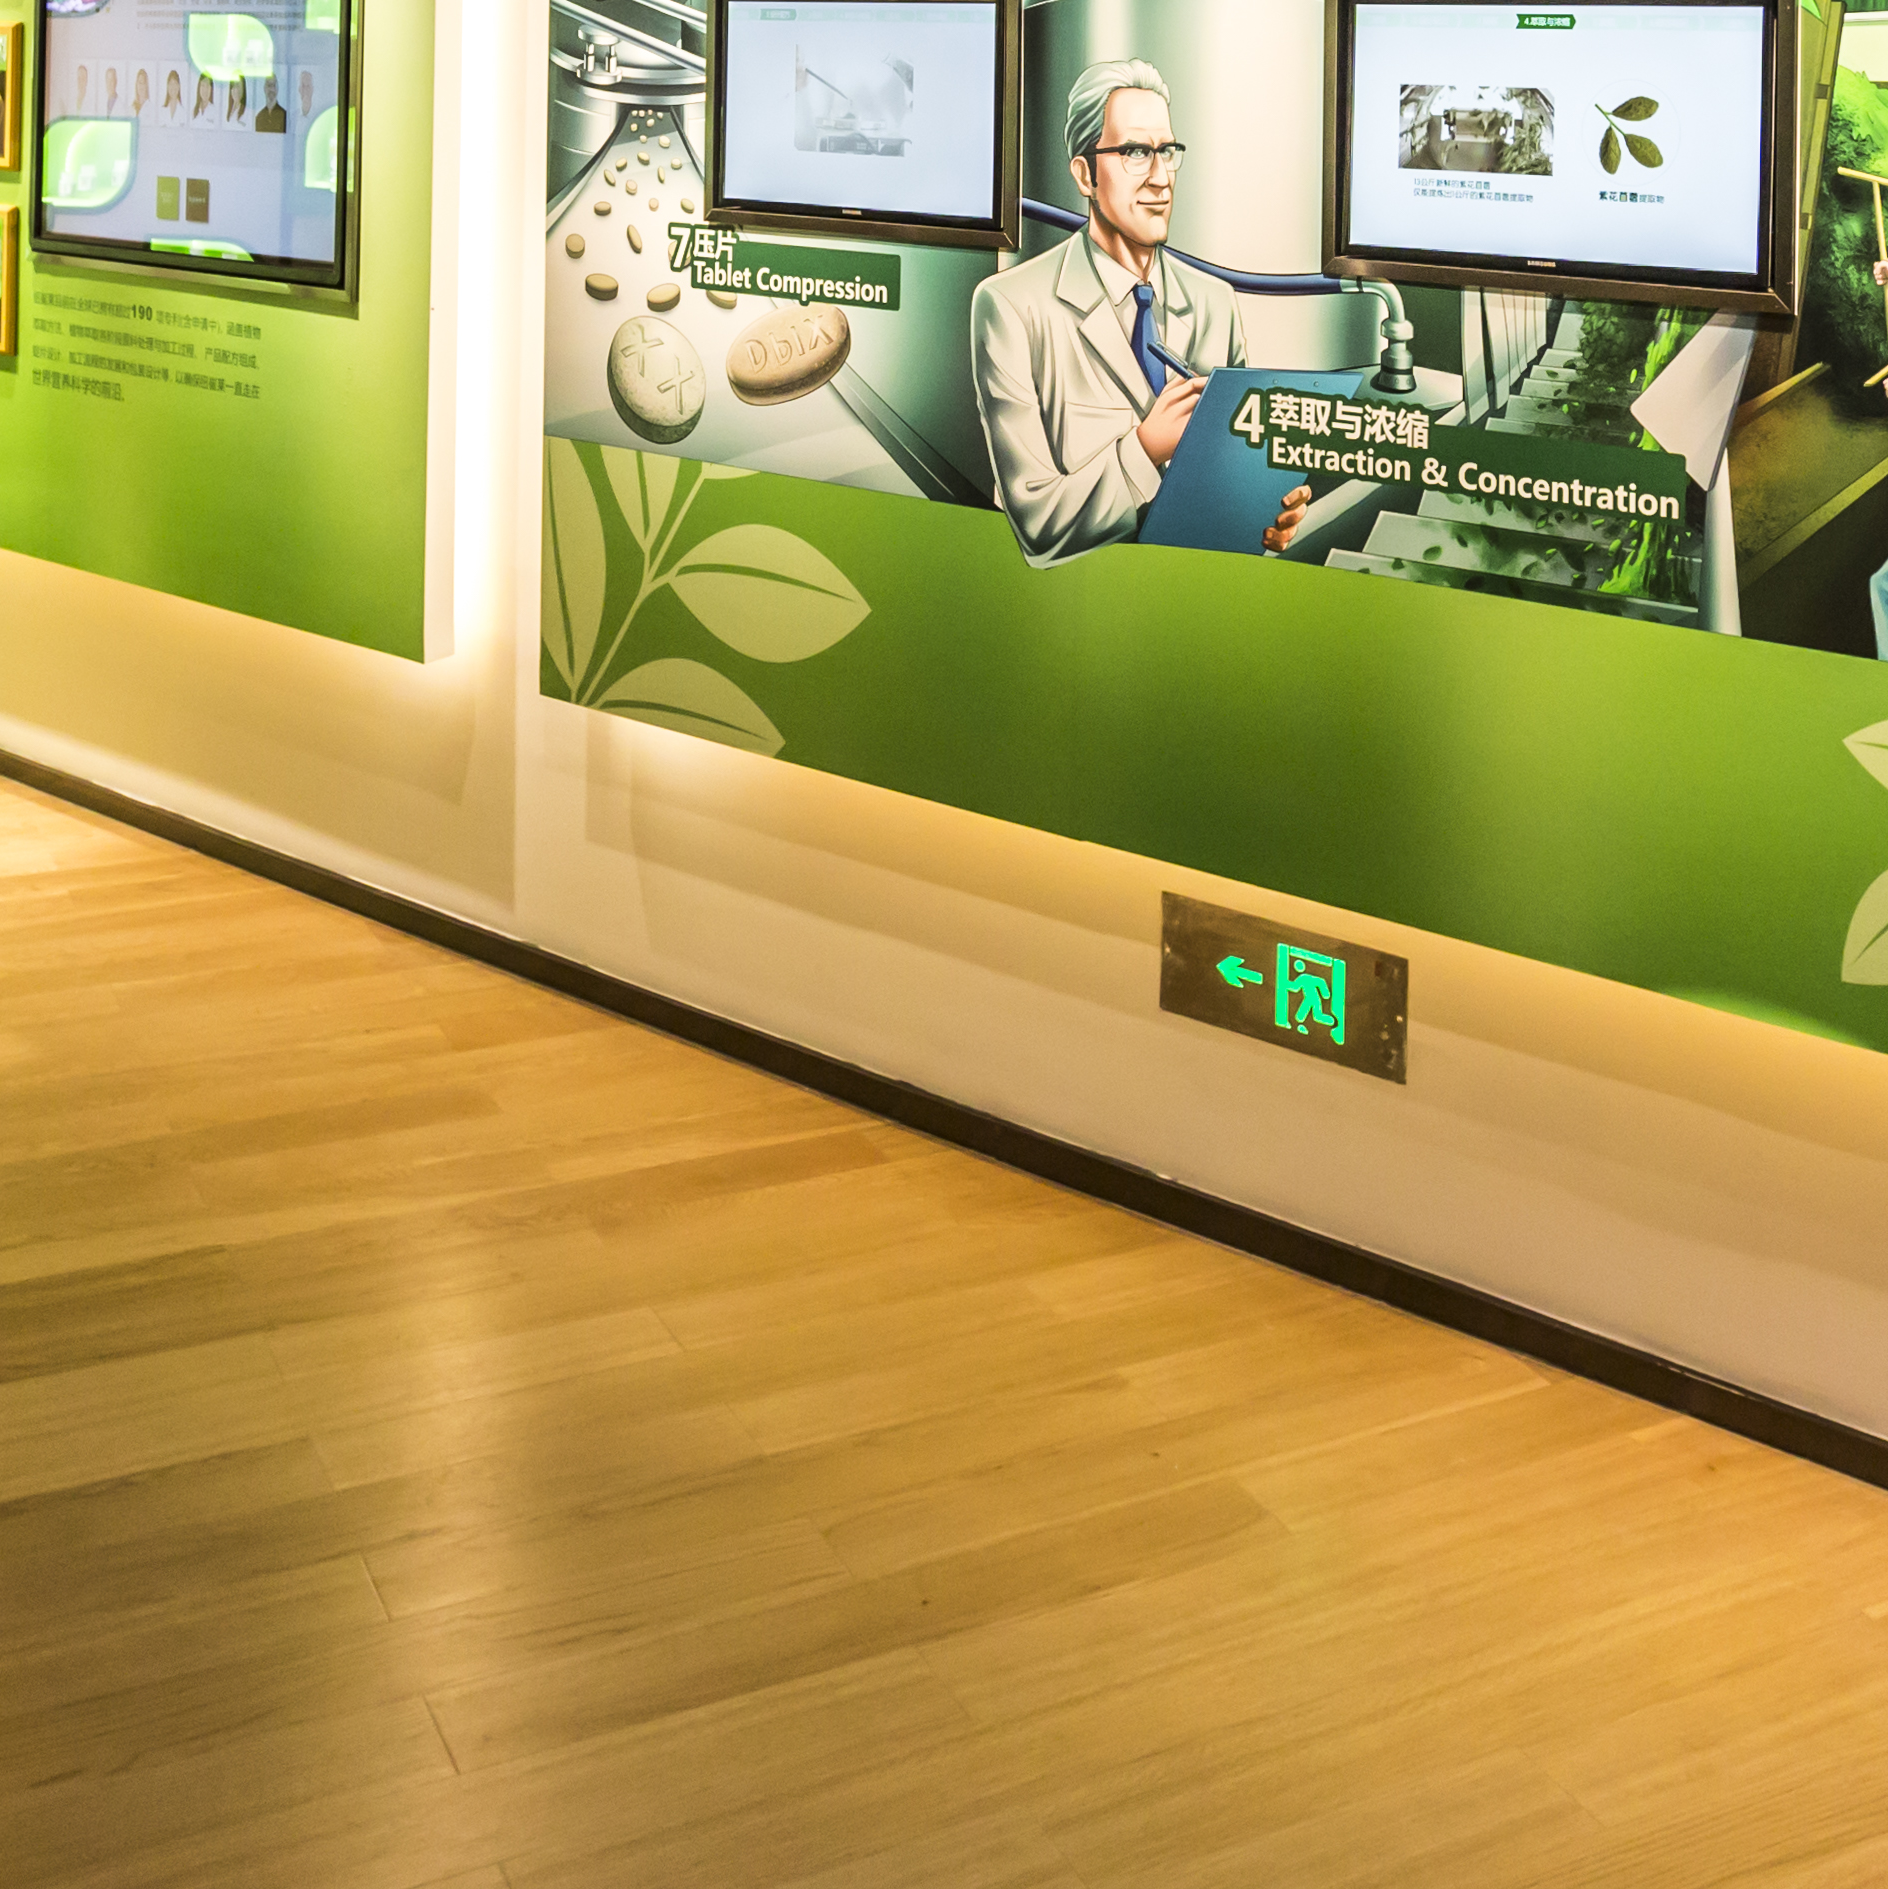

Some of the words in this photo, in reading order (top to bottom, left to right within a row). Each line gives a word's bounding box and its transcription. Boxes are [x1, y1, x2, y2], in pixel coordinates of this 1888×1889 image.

[693, 229, 737, 262] 压片
[693, 260, 752, 290] Tablet
[756, 267, 888, 304] Compression
[1268, 393, 1430, 450] 萃取与浓缩
[1272, 436, 1411, 482] Extraction
[1421, 457, 1449, 488] &
[1457, 462, 1681, 520] Concentration
